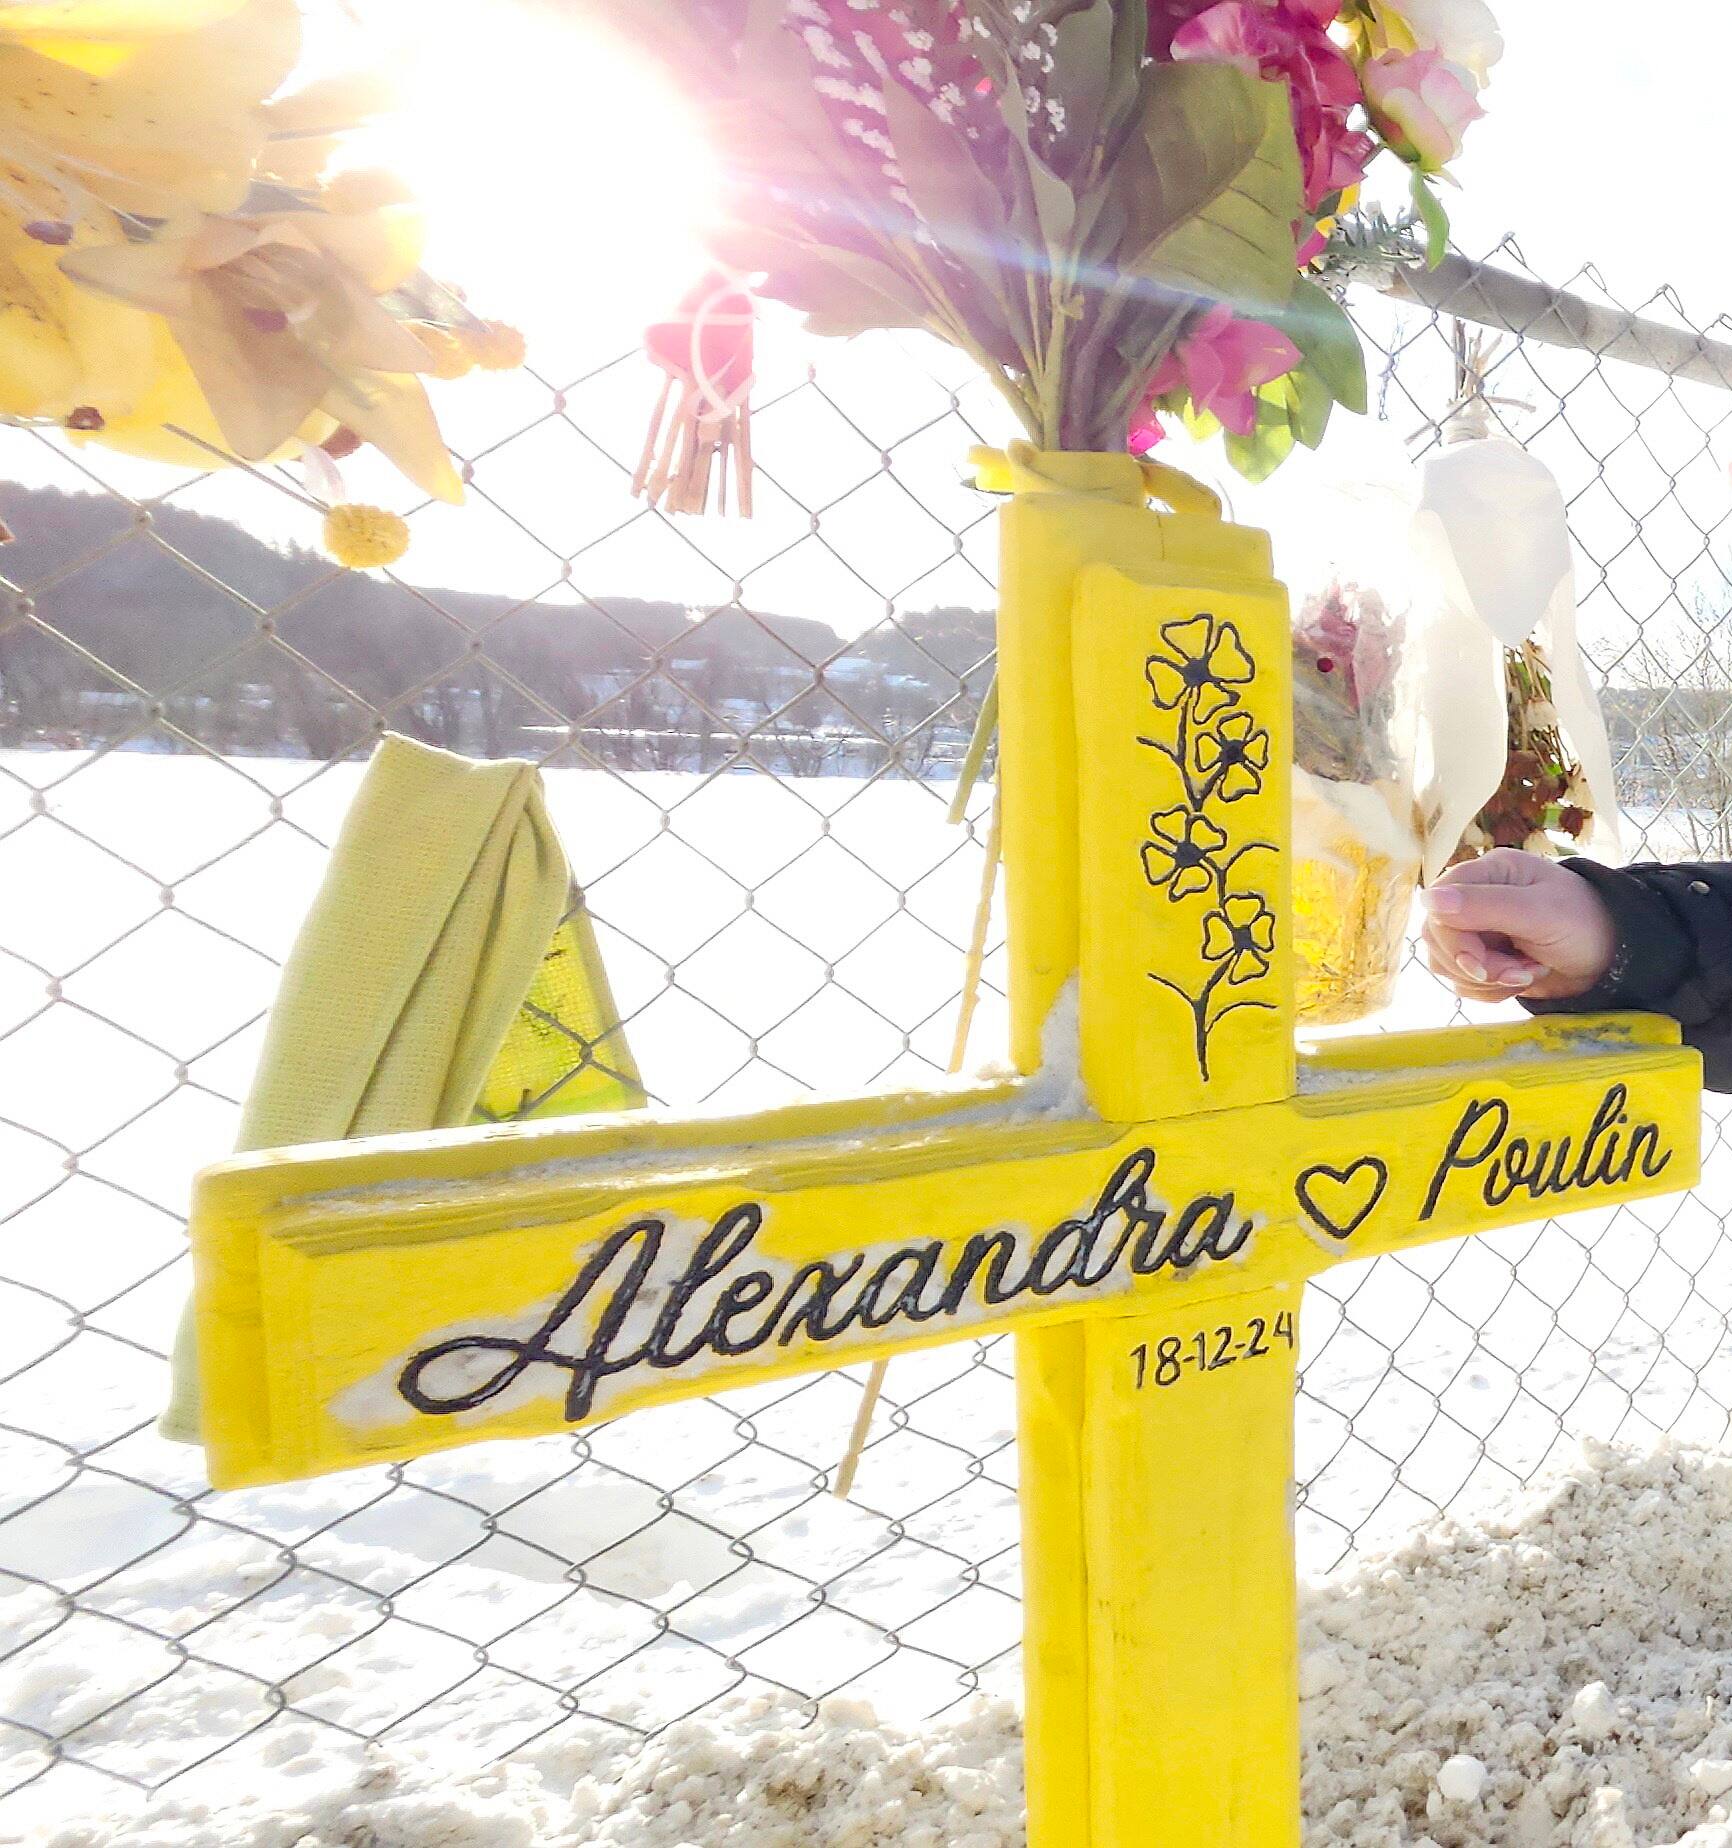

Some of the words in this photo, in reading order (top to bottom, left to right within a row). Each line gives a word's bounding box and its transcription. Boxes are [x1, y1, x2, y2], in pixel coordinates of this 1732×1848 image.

[399, 1147, 1256, 1421] Alexandra
[1419, 1082, 1673, 1221] Poulin
[1130, 1311, 1293, 1389] 18-12-24
